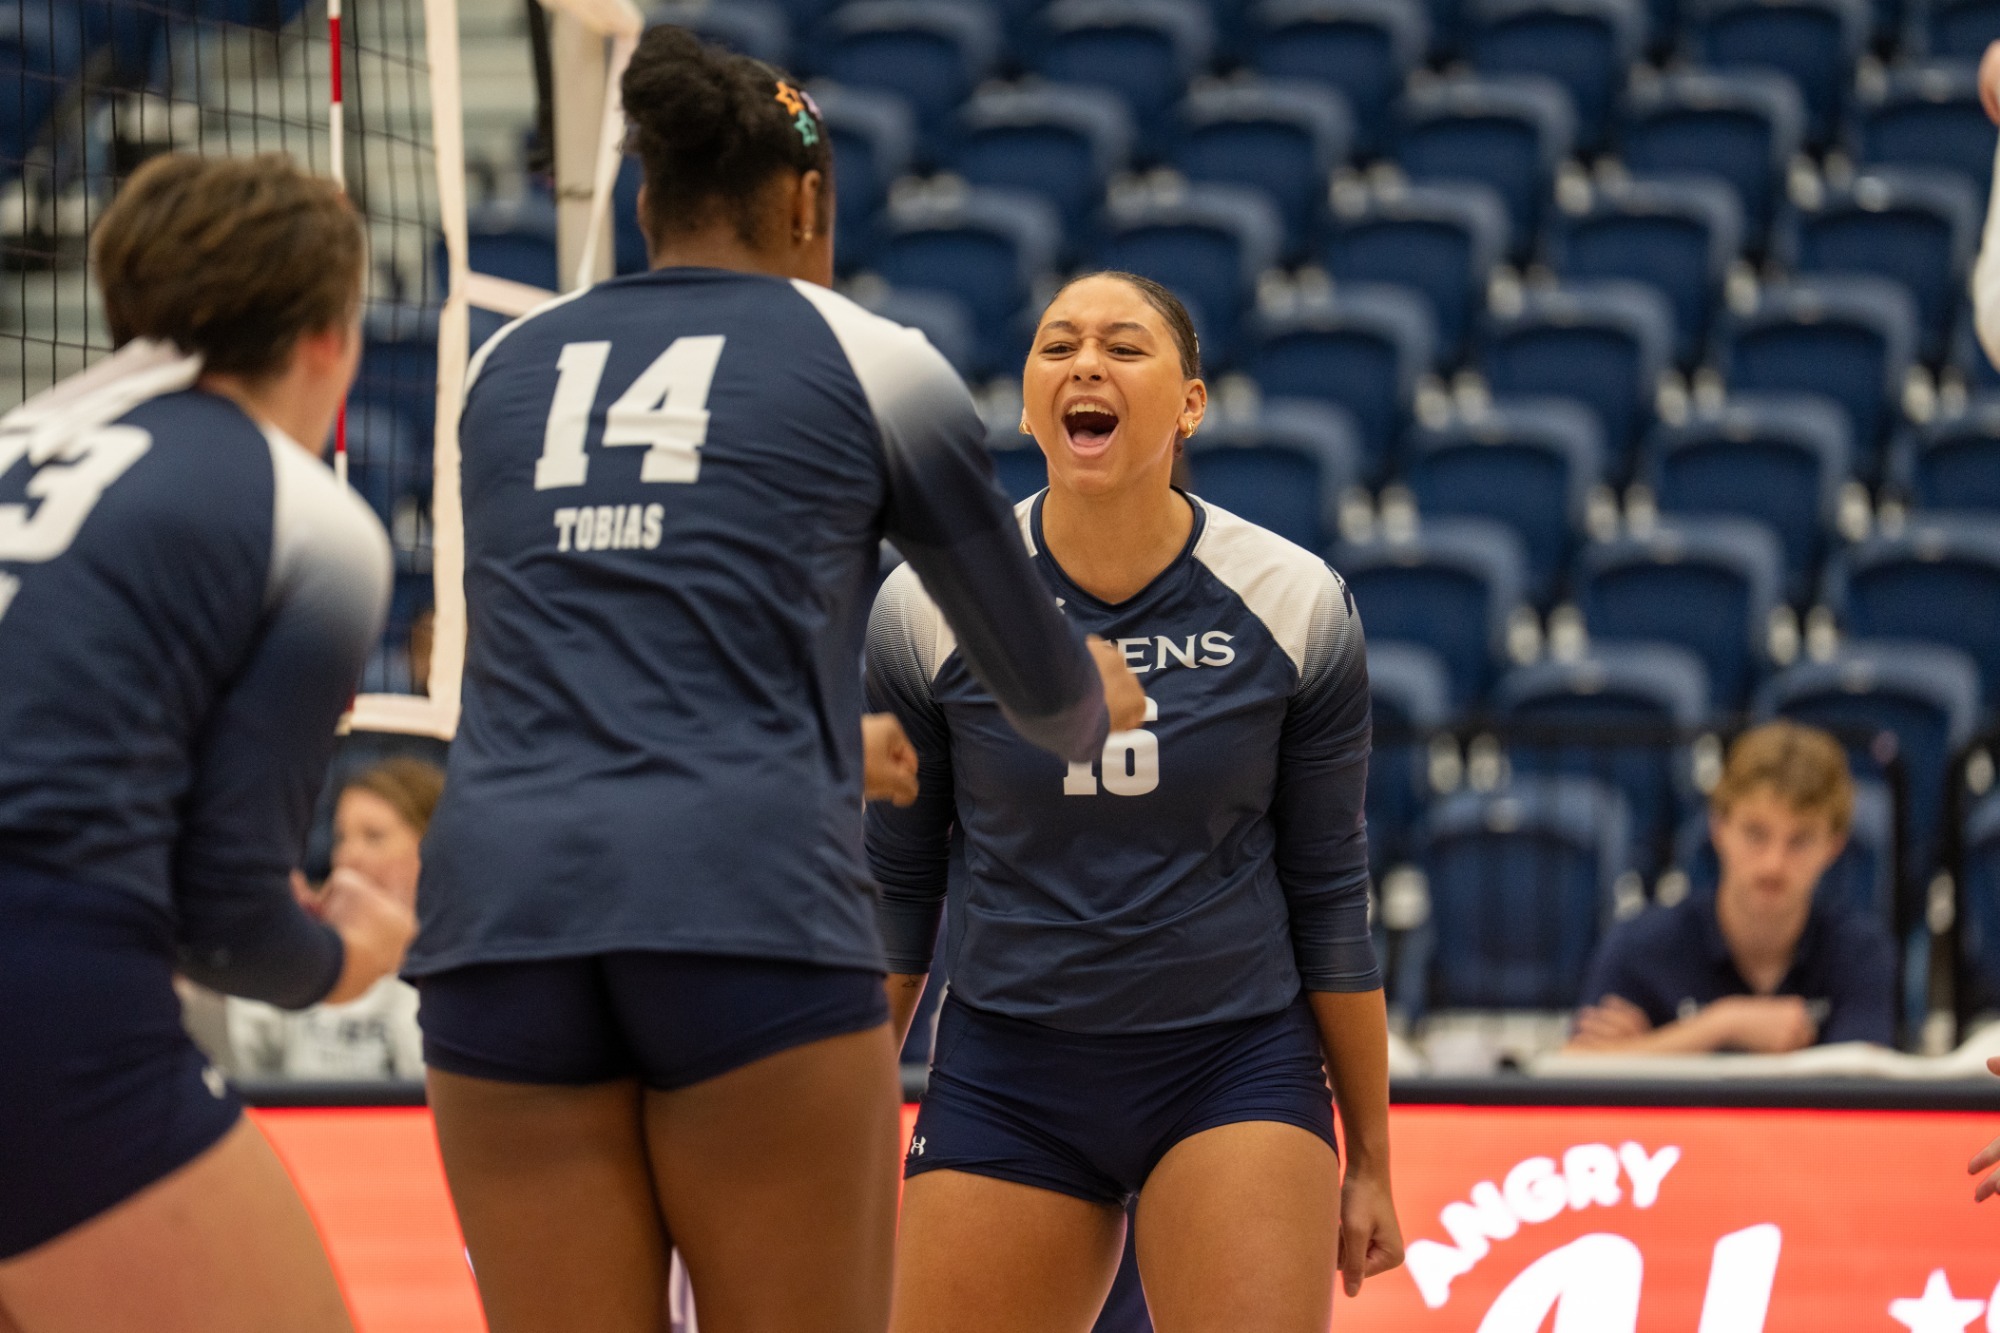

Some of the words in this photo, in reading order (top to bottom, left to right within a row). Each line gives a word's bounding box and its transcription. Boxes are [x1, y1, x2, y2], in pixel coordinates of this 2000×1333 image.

[534, 334, 726, 491] 14
[0, 424, 153, 563] 3
[553, 502, 665, 552] TOBIAS
[1107, 630, 1236, 674] ENS
[1404, 1141, 1681, 1308] ANGRY
